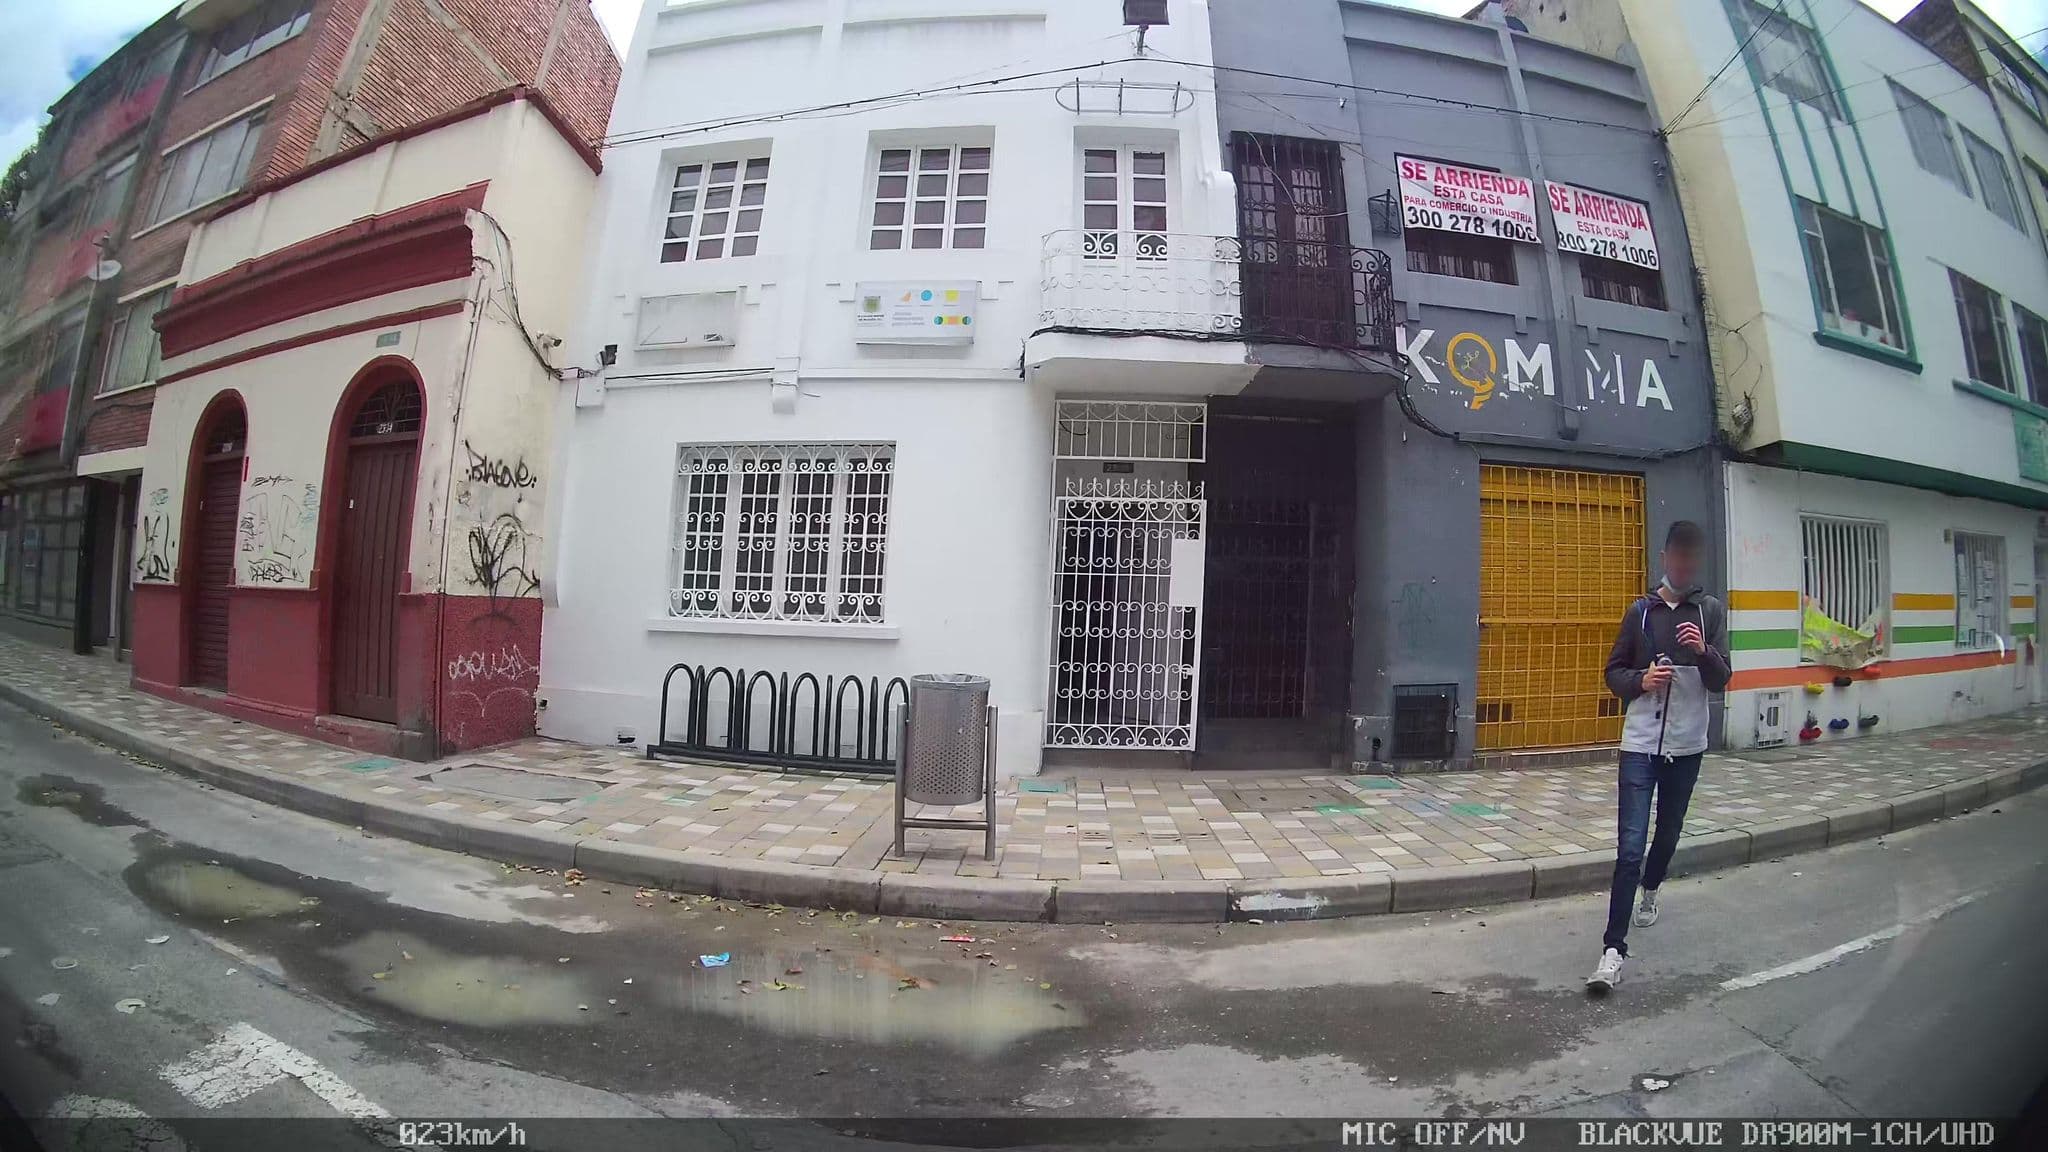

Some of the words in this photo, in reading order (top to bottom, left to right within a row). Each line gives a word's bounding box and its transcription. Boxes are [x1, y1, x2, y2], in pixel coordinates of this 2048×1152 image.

[1401, 160, 1428, 181] SE
[1434, 166, 1530, 198] ARRIENDA
[1404, 195, 1427, 207] PARA
[1429, 200, 1478, 214] COMERCIO
[1480, 206, 1487, 214] O
[1489, 207, 1534, 225] INDUSTRIA
[1434, 185, 1467, 200] ESTA
[1470, 191, 1504, 206] CASA
[1548, 184, 1571, 214] SE
[1574, 190, 1648, 231] ARRIENDA
[1407, 206, 1443, 229] 300
[1448, 213, 1485, 234] 278
[1577, 220, 1603, 236] ESTA
[1605, 227, 1630, 241] CASA
[1559, 231, 1587, 252] 300
[1591, 239, 1618, 259] 278
[1622, 245, 1657, 267] 1006
